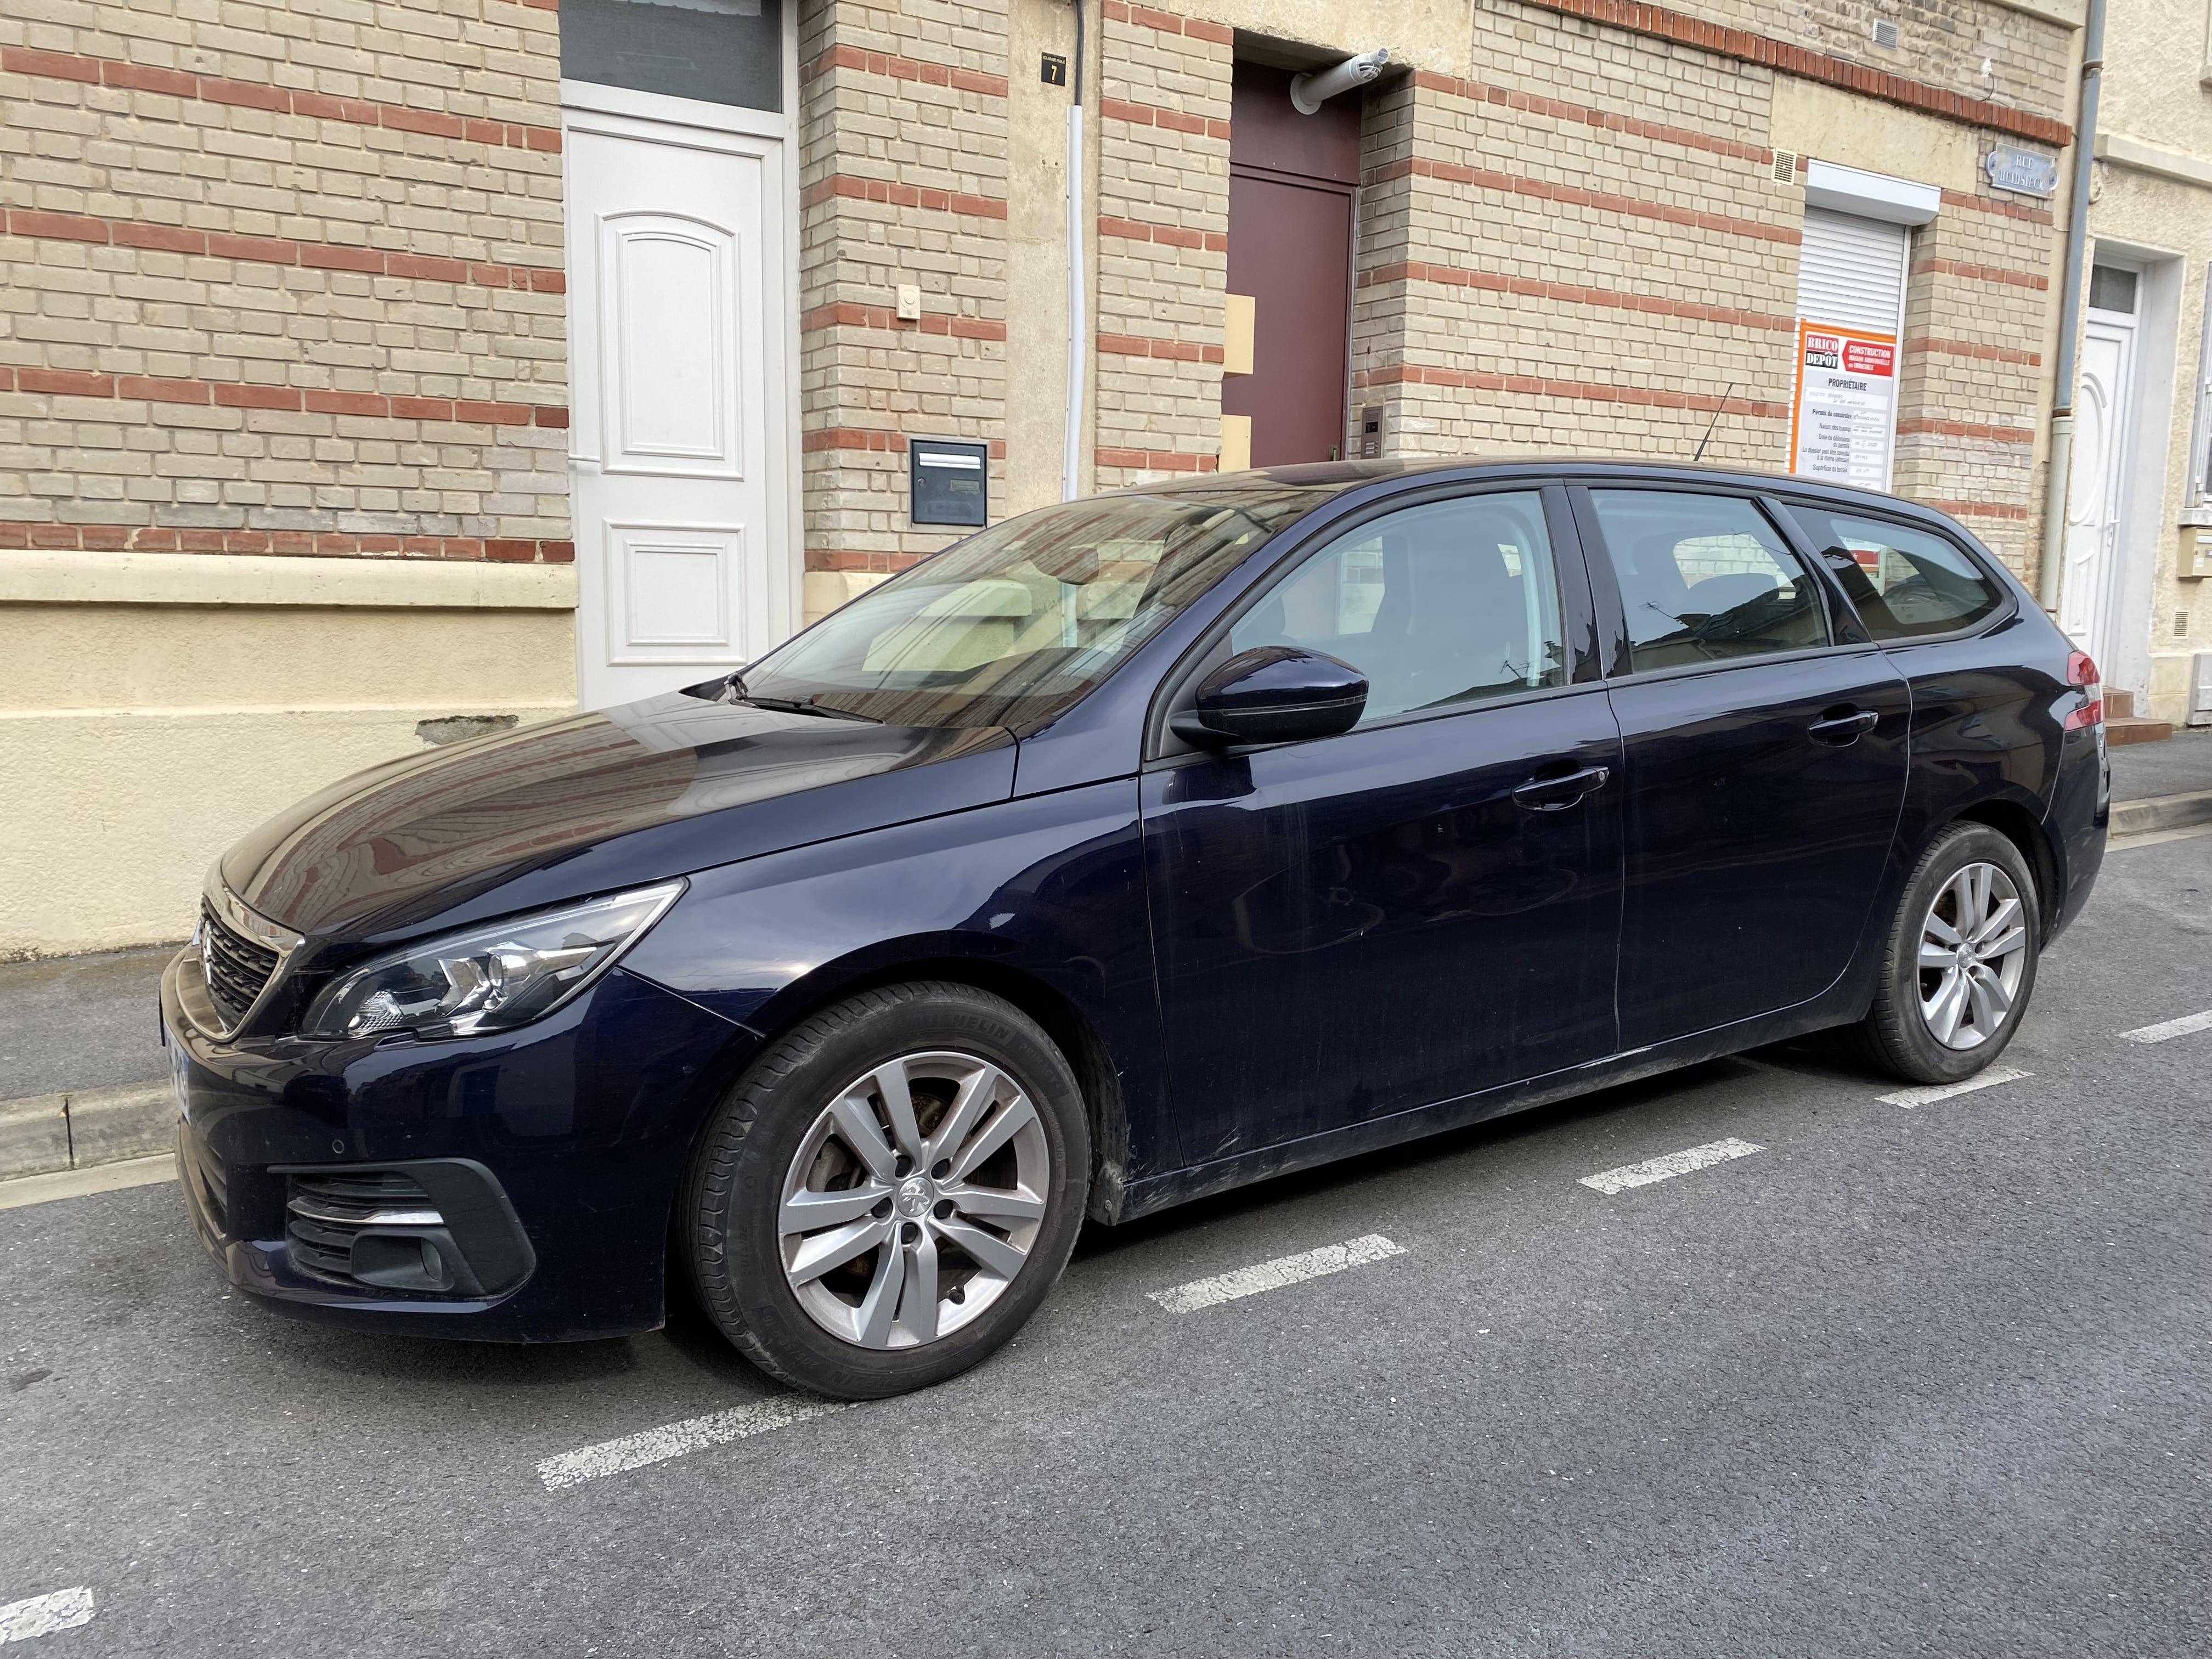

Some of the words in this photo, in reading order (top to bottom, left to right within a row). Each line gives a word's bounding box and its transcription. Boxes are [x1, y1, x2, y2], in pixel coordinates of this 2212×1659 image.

[1051, 65, 1057, 83] 7
[2015, 155, 2033, 170] RUE
[1999, 170, 2044, 190] HEIDSIECK
[1808, 337, 1838, 351] BRICO
[1849, 345, 1891, 358] CONSTRUCTION
[1807, 351, 1838, 367] DEPÔT
[1864, 357, 1891, 365] INDIVIDUELLE
[1828, 378, 1867, 391] PROPRIÉTAIRE
[907, 1013, 1012, 1044] MICHELIN
[1018, 1042, 1059, 1085] PRIMACY
